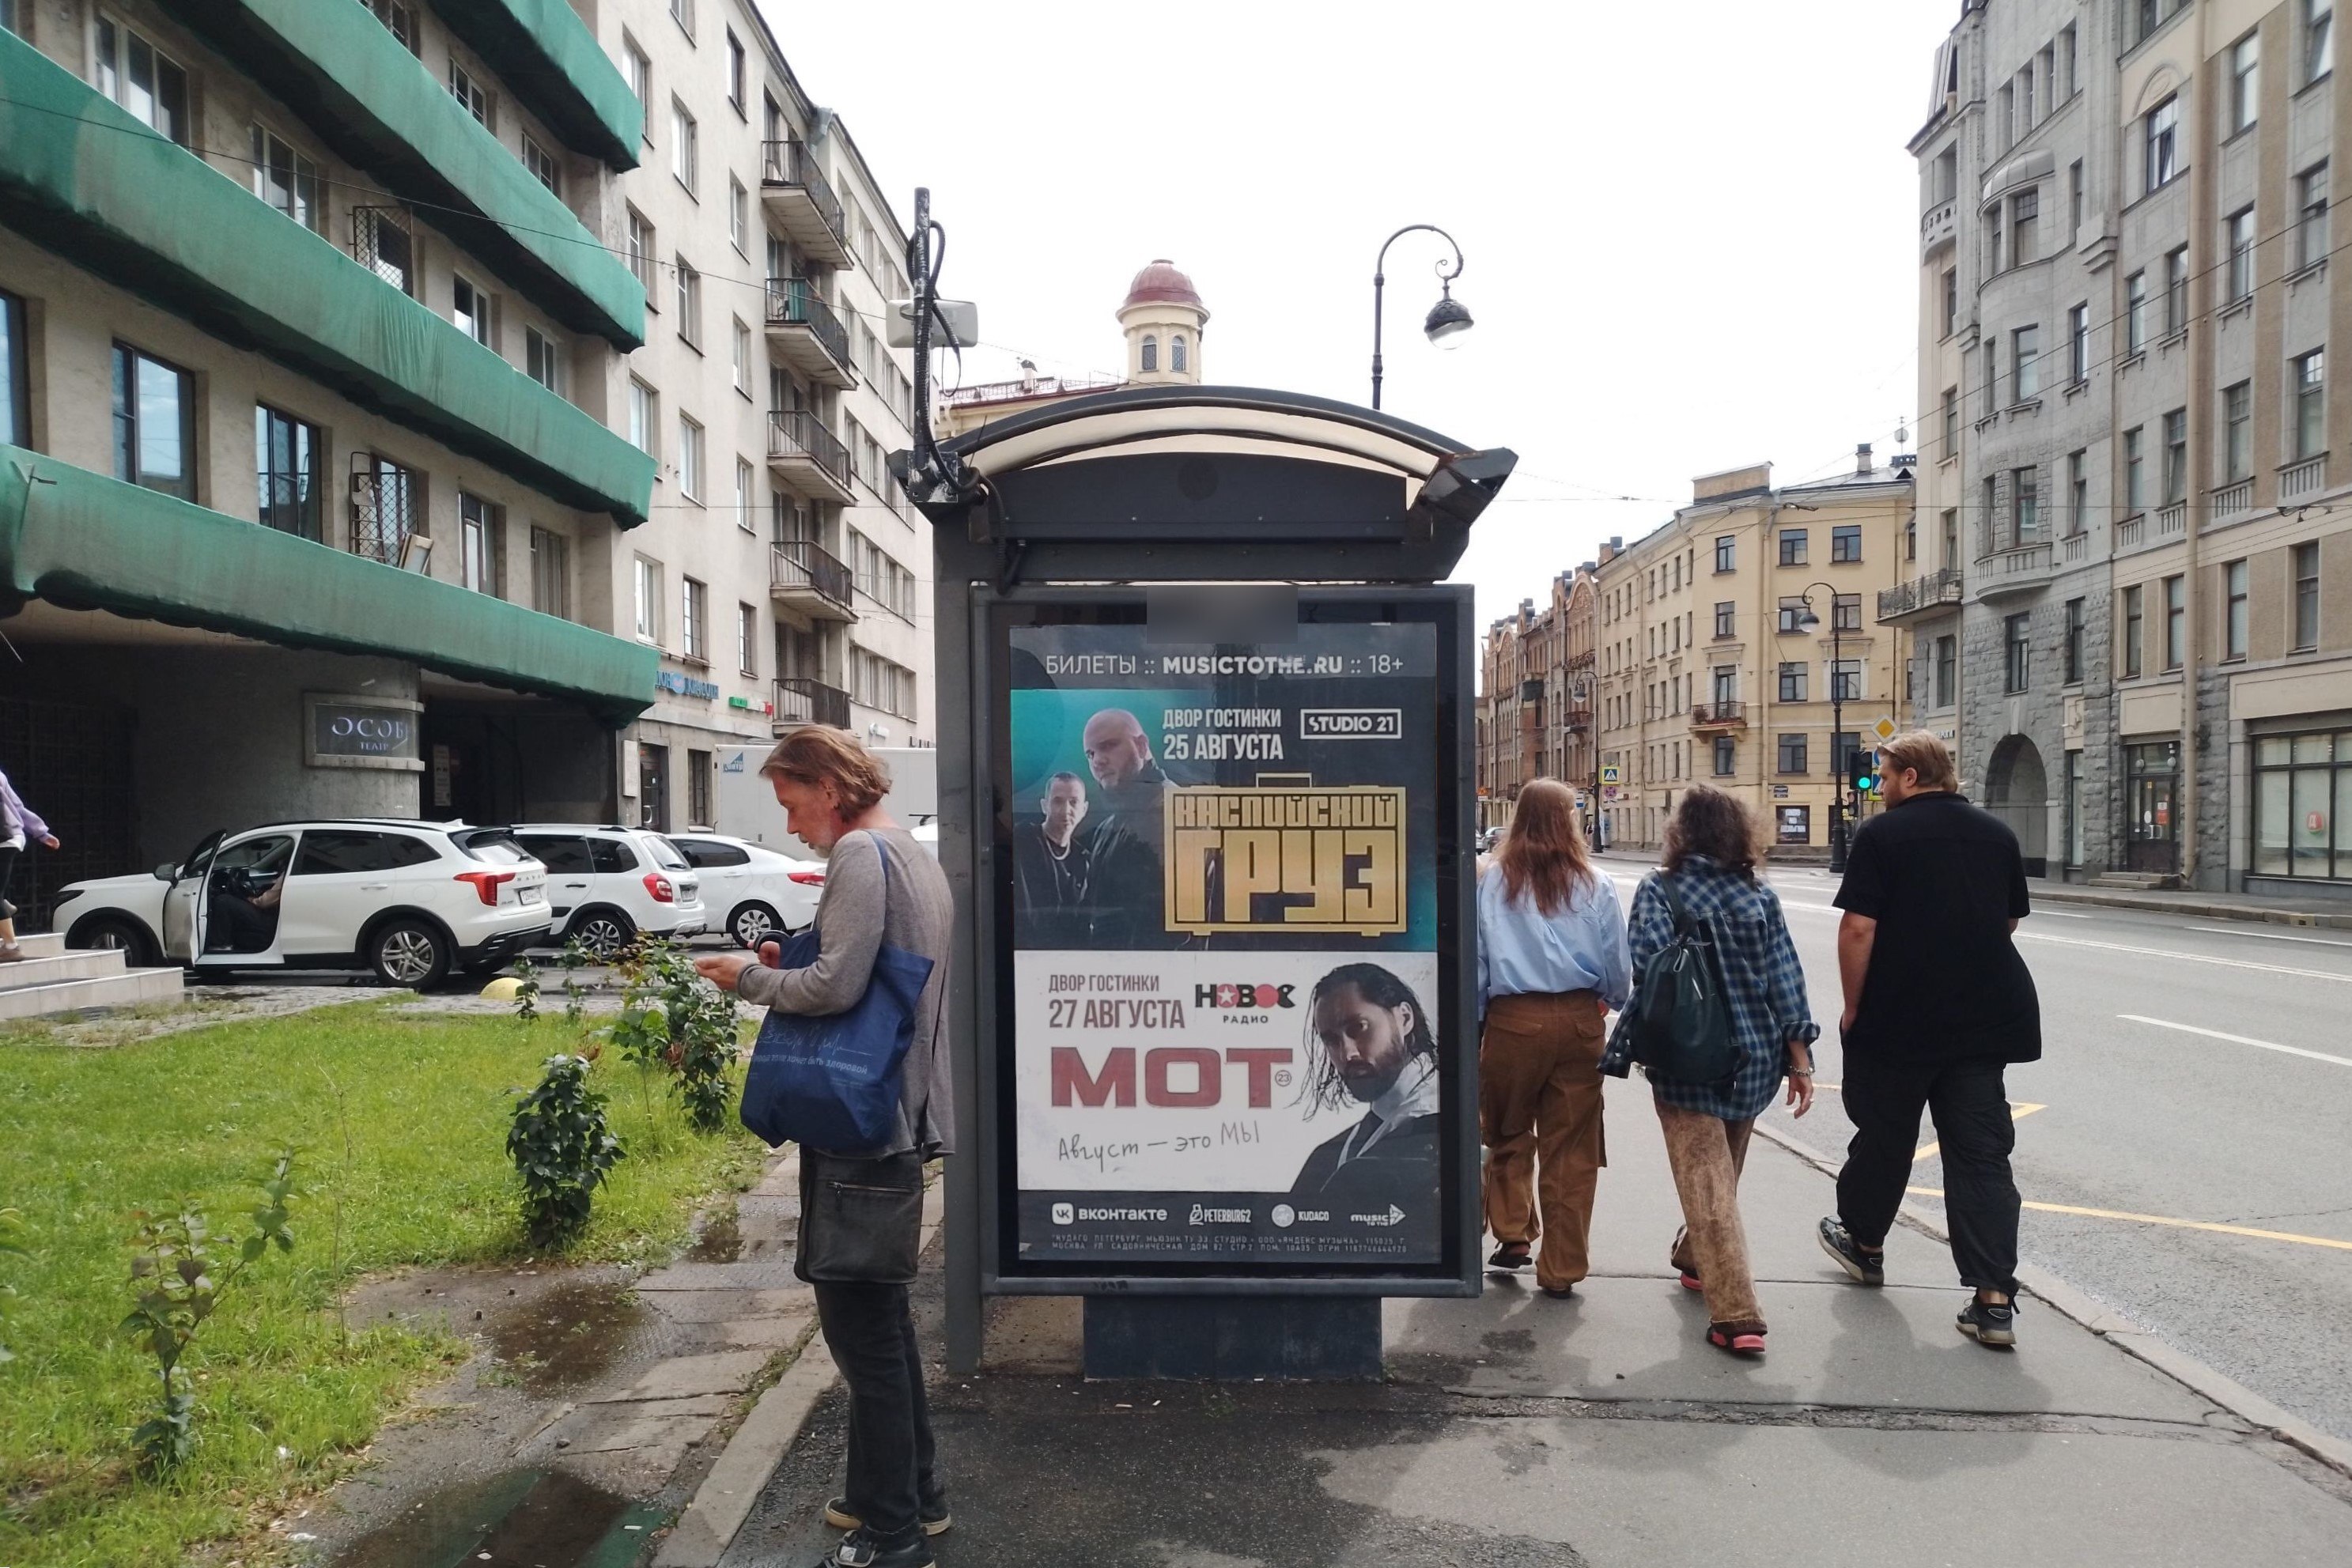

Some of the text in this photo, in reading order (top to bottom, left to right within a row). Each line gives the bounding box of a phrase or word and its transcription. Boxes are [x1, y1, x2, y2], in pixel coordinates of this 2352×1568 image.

[1046, 655, 1136, 674] БИЛЕТЫ
[1163, 656, 1343, 674] MUSICTOTHE.RU
[1367, 654, 1404, 674] 18+
[1163, 708, 1282, 729] ДВОР ГОСТИНКИ
[1308, 716, 1394, 732] STUDIO 21
[360, 741, 389, 751] ТЕАТР
[1163, 734, 1284, 761] 25 АВГУСТА
[1174, 795, 1397, 828] КАСПИЙСКИЙ
[1175, 829, 1397, 923] ГРУЗ
[1048, 974, 1160, 994] ДВОР ГОСТИНКИ
[1049, 999, 1186, 1029] 27 АВГУСТА
[1222, 1014, 1269, 1025] РАДИО
[826, 1058, 868, 1075] здоровой
[1050, 1046, 1294, 1109] МОТ
[1276, 1071, 1291, 1084] 23
[1058, 1133, 1139, 1173] Август
[1174, 1135, 1211, 1152] это
[1298, 1210, 1329, 1222] KUDAGO
[1349, 1213, 1389, 1222] music
